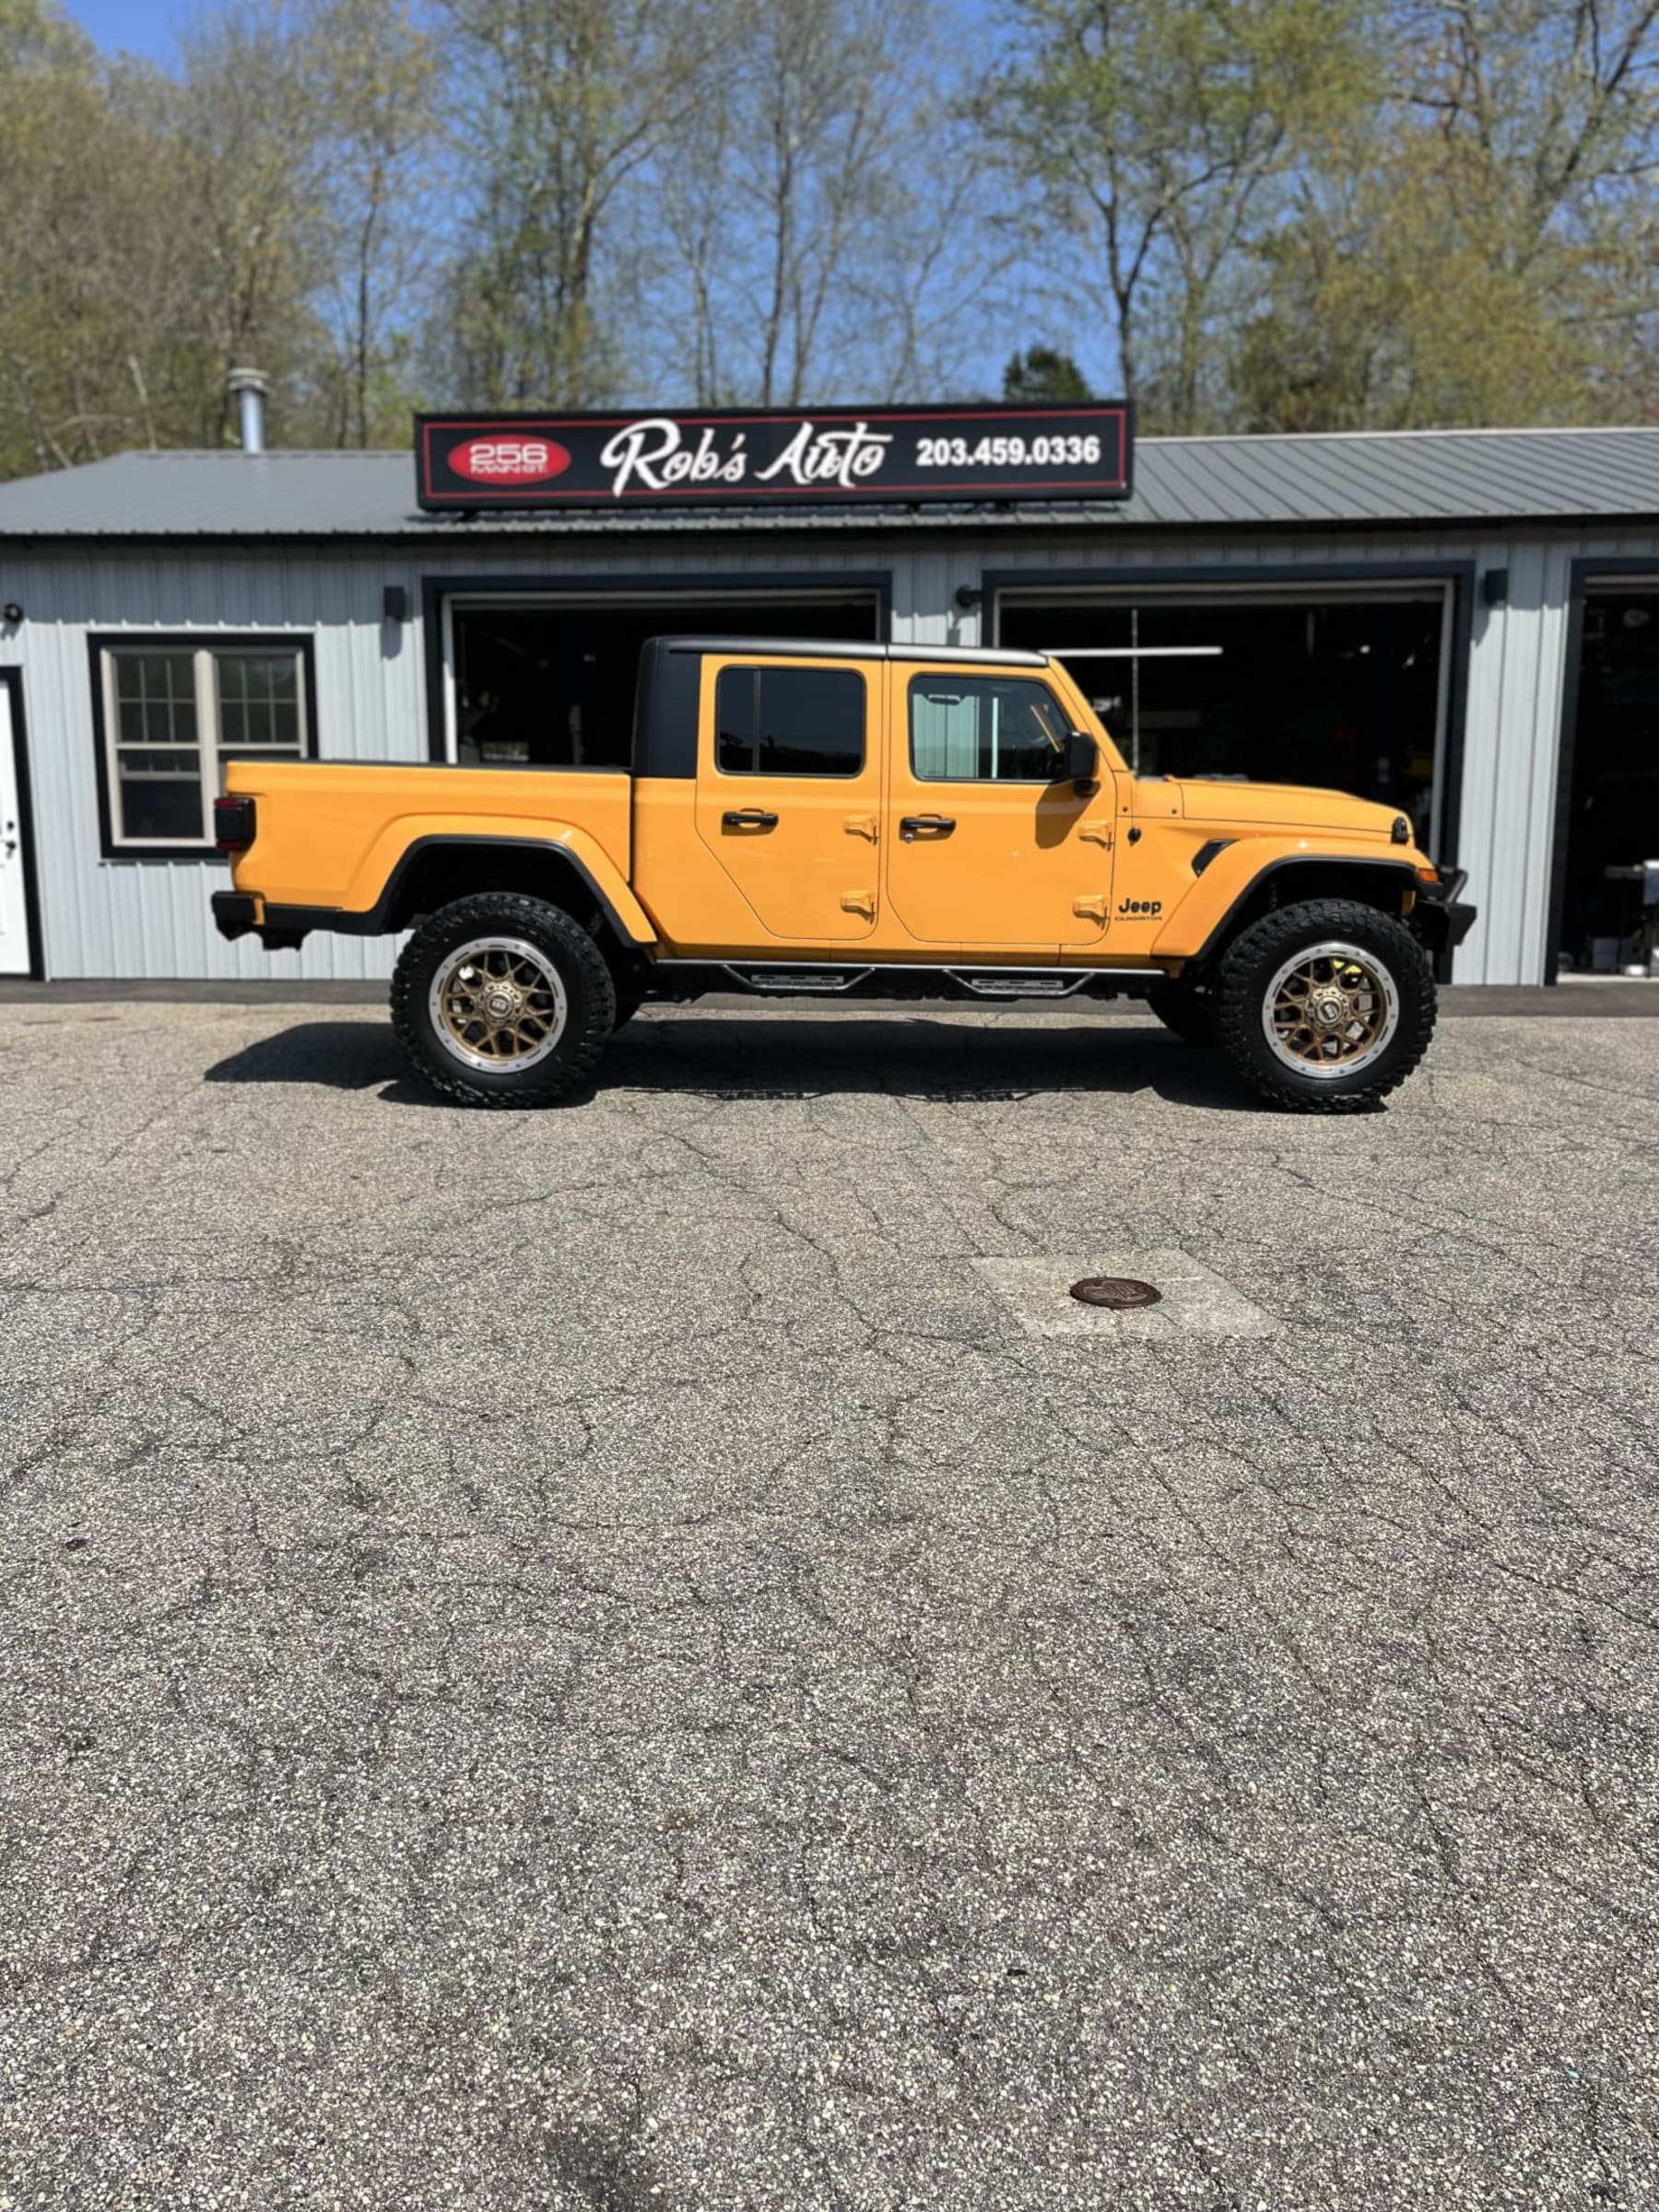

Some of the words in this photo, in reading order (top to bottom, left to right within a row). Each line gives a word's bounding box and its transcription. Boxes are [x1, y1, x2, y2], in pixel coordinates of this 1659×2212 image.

[470, 443, 547, 465] 256
[600, 418, 747, 498] Rob's
[755, 421, 894, 488] Auto
[916, 435, 1100, 466] 203.459.0336
[471, 464, 521, 474] MAIN
[1118, 898, 1162, 915] Jeep
